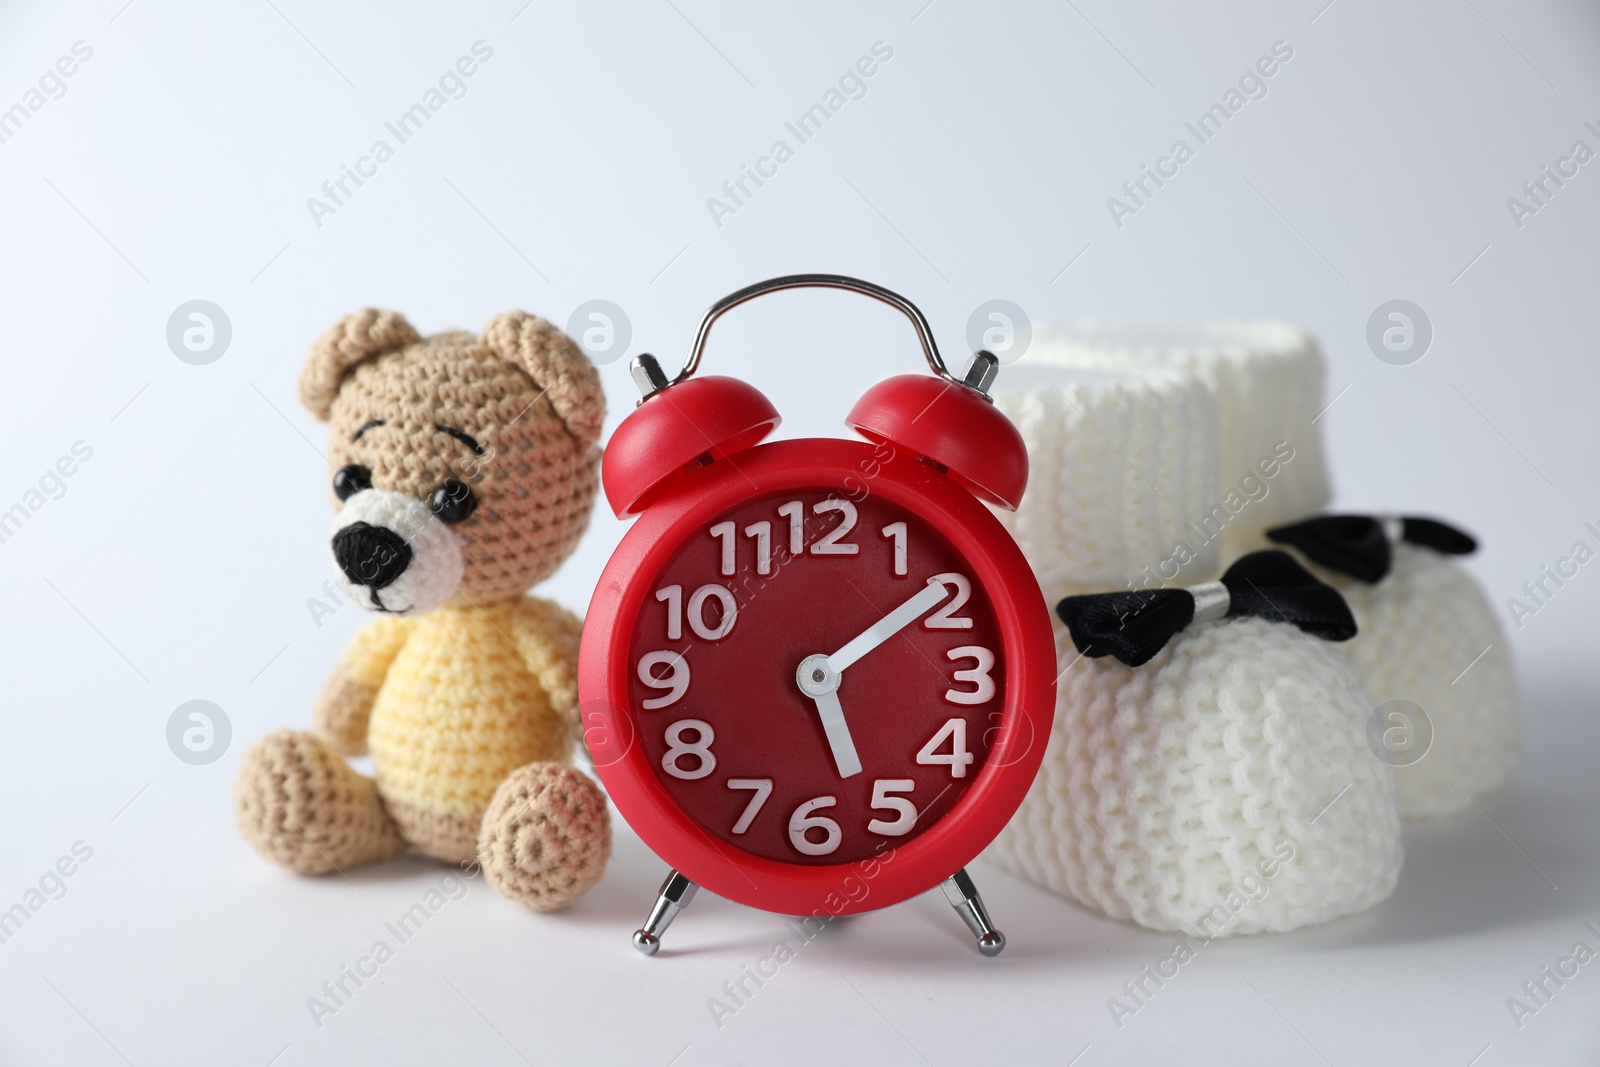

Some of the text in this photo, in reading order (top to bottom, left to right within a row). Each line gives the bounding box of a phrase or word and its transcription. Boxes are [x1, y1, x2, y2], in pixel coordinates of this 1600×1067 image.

[709, 521, 771, 575] 11
[778, 501, 859, 554] 12
[882, 522, 907, 575] 1
[656, 584, 737, 640] 10
[924, 573, 974, 628] 2
[637, 650, 691, 709] 9
[945, 646, 996, 705] 3
[661, 719, 717, 779] 8
[916, 718, 974, 778] 4
[727, 779, 773, 834] 7
[788, 797, 842, 855] 6
[867, 780, 917, 836] 5
